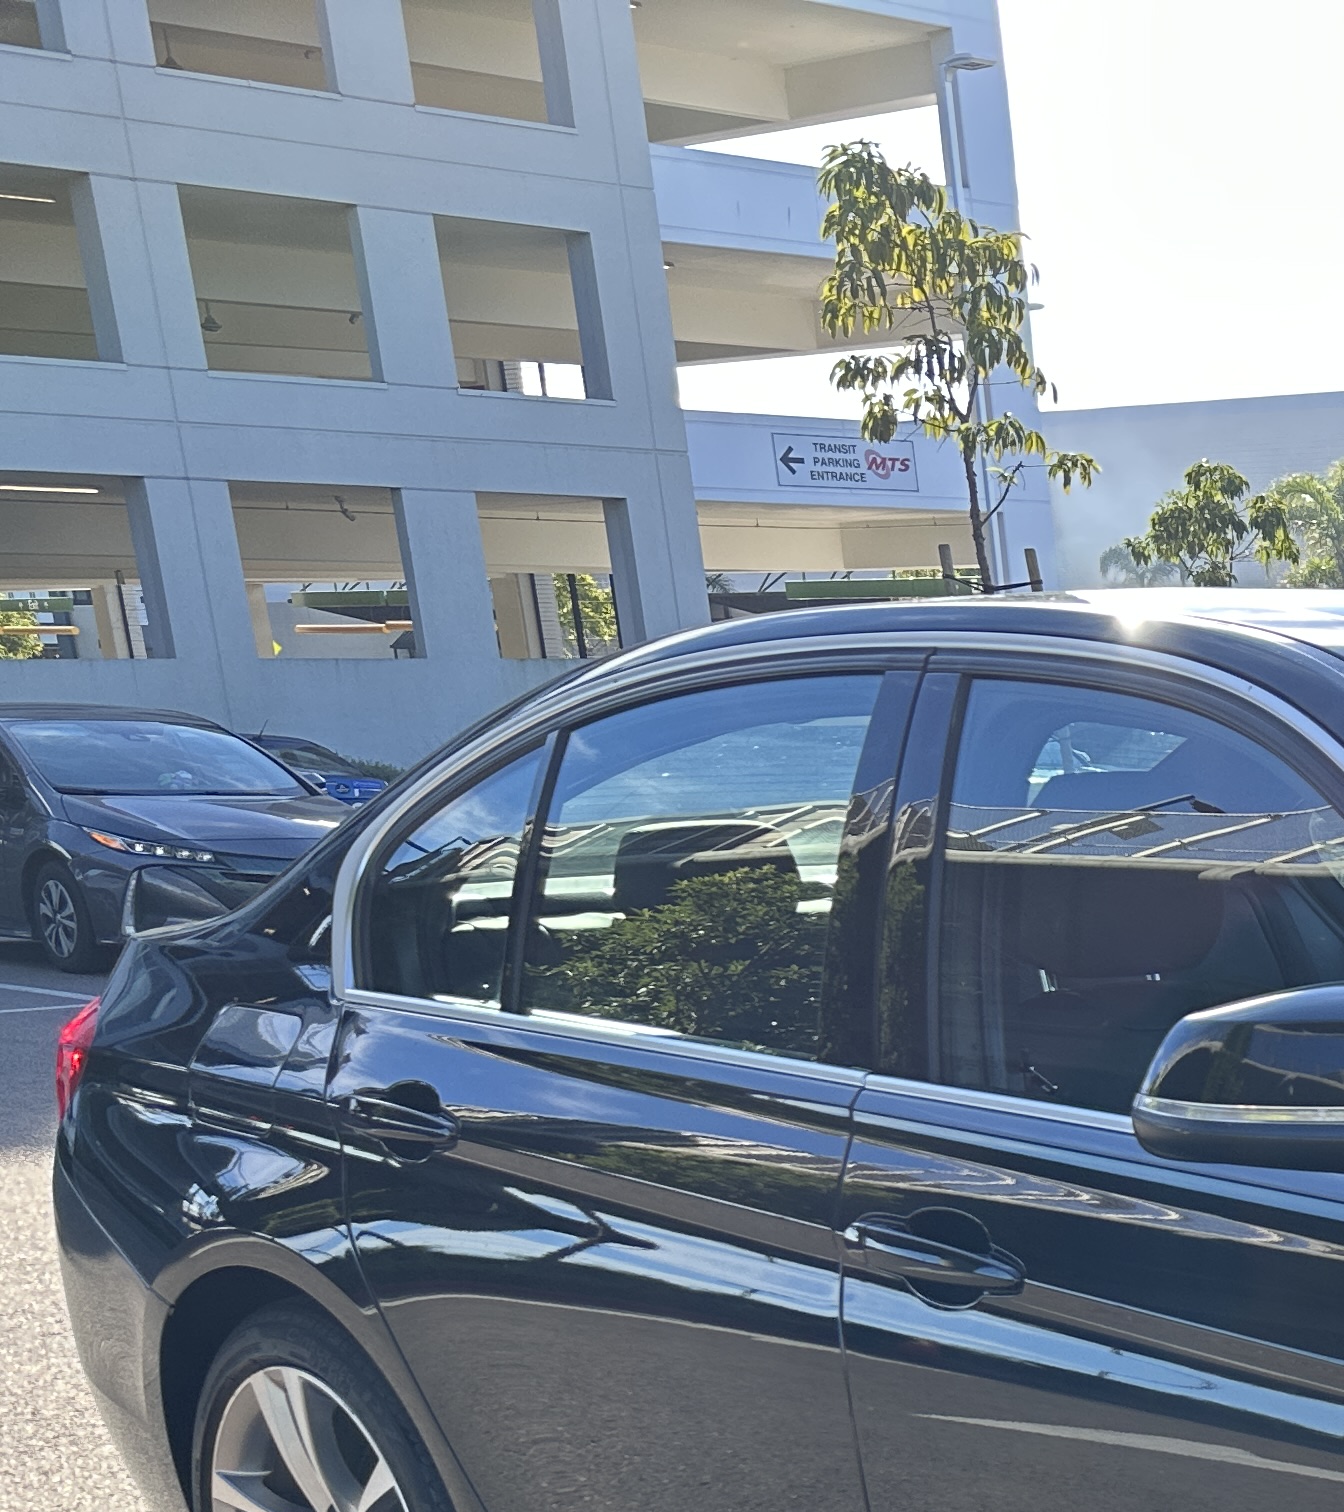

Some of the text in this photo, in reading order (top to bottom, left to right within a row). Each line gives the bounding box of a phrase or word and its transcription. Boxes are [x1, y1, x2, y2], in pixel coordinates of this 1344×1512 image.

[812, 442, 857, 455] TRANSIT
[813, 456, 860, 469] PARKING
[867, 457, 911, 472] MTS
[810, 470, 867, 483] ENTRANCE
